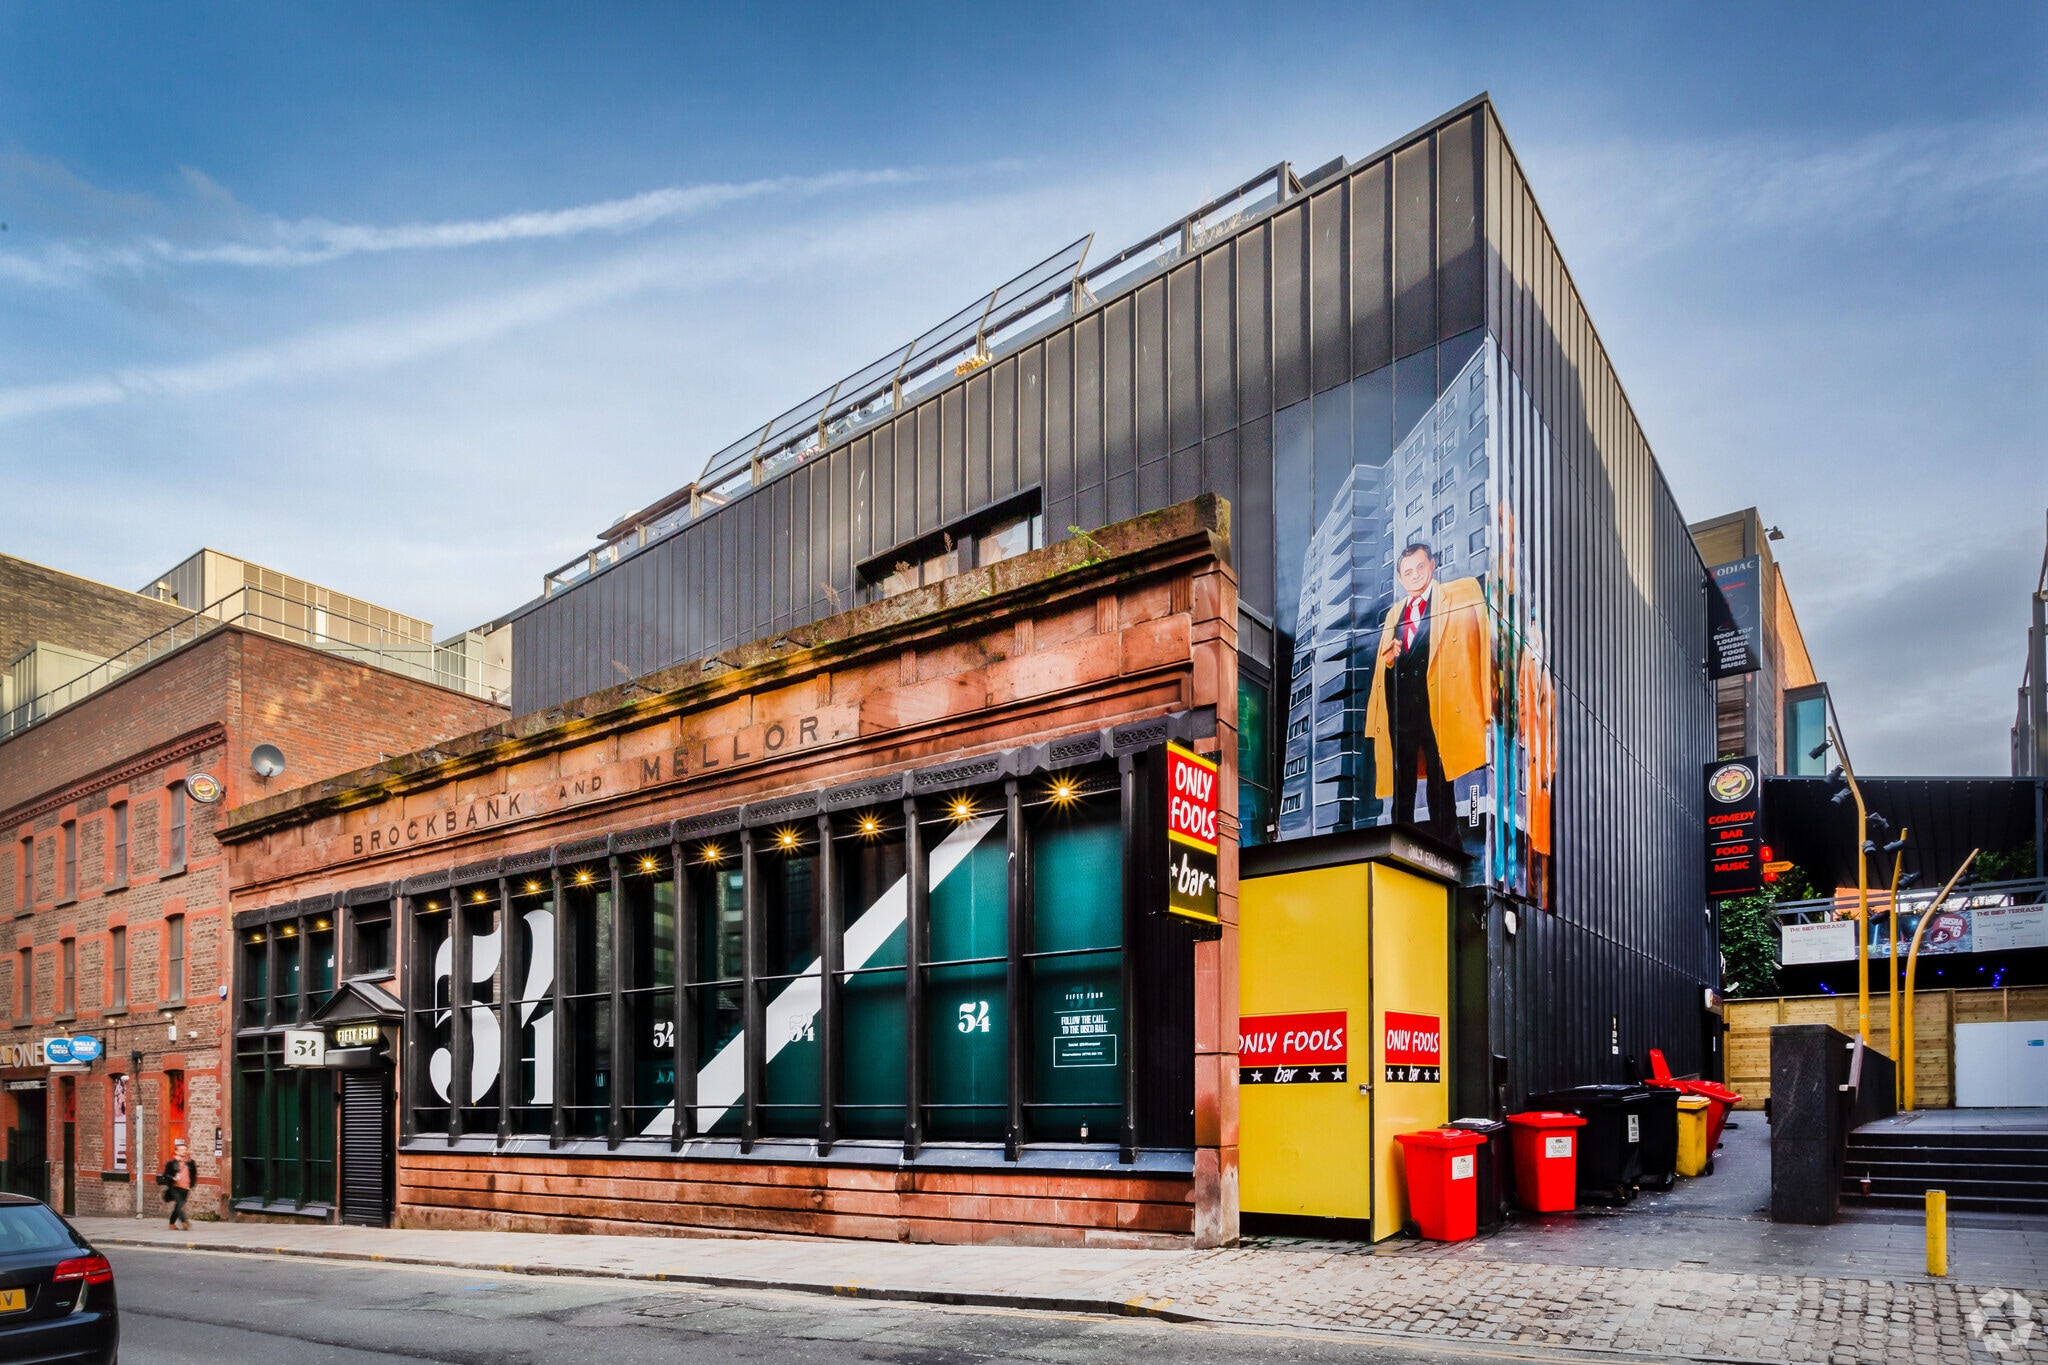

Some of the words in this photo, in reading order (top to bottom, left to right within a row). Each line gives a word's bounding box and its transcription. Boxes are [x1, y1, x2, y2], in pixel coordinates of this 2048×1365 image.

[1714, 630, 1735, 640] ROOF
[1737, 627, 1754, 635] TOP
[1717, 634, 1750, 646] LOUNGE
[1719, 640, 1749, 651] SHISHA
[1722, 648, 1745, 656] FOOD
[1721, 654, 1746, 663] DRINK
[1721, 660, 1747, 669] MUSIC
[1175, 761, 1213, 802] ONLY
[352, 792, 521, 855] BROCKBANK
[558, 775, 602, 800] AND
[1171, 796, 1216, 840] FOOLS
[1708, 811, 1755, 824] COMEDY
[1720, 830, 1743, 839] BAR
[1716, 845, 1748, 856] FOOD
[1714, 861, 1749, 872] MUSIC
[1178, 853, 1209, 896] bar
[958, 1000, 991, 1033] 54
[1061, 1016, 1080, 1025] FOLLOW
[1081, 1015, 1091, 1024] THE
[337, 1028, 357, 1041] FIFTY
[359, 1026, 378, 1039] FOUR
[654, 1021, 674, 1048] 54
[788, 1012, 815, 1042] 54
[1062, 1026, 1069, 1034] TO
[1070, 1025, 1079, 1034] THE
[1080, 1024, 1094, 1033] DISCO
[1095, 1024, 1107, 1032] BALL
[294, 1040, 316, 1056] 54
[1283, 1028, 1343, 1053] FOOLS
[1387, 1029, 1410, 1051] ONLY
[1412, 1031, 1439, 1053] FOOLS
[1274, 1064, 1298, 1083] bar
[1409, 1063, 1421, 1082] bar
